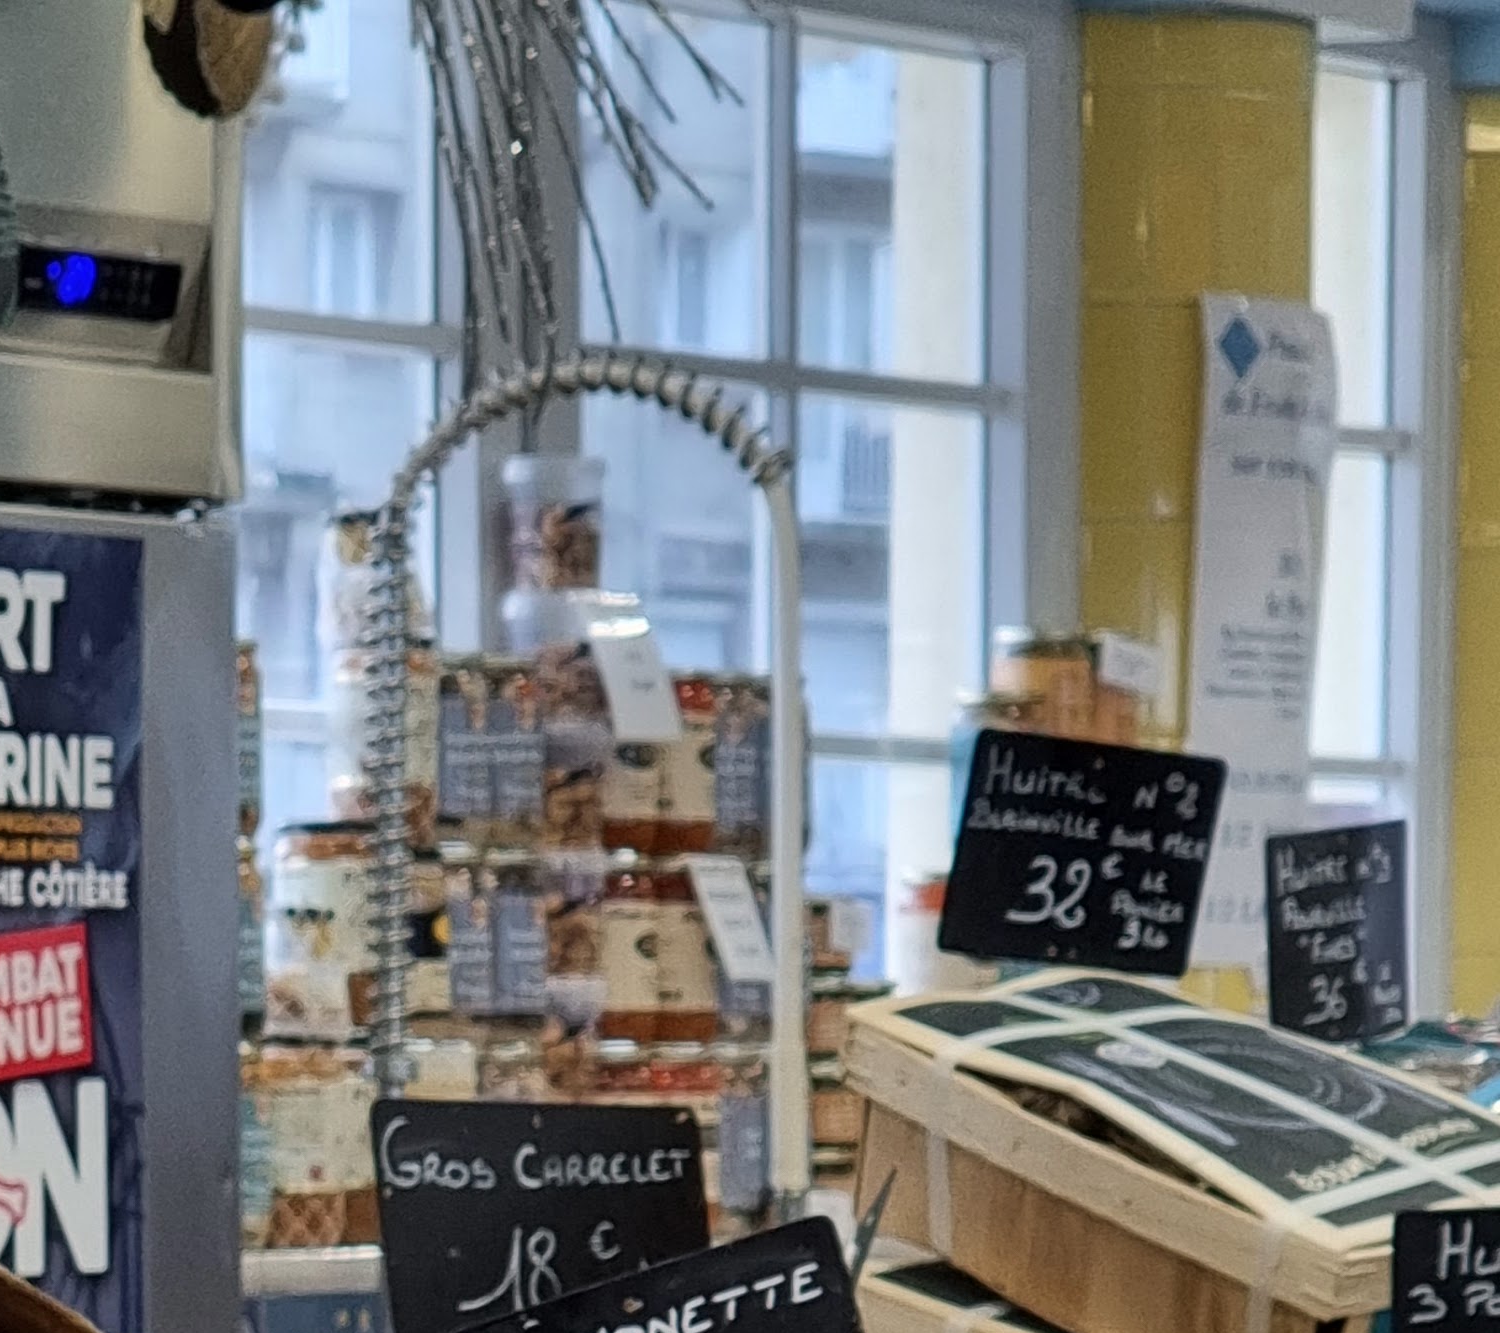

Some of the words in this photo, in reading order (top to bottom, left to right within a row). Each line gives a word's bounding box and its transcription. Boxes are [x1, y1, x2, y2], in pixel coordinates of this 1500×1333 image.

[513, 1143, 692, 1190] CARRELET
[457, 1226, 564, 1312] 18
[1406, 1281, 1450, 1325] 3
